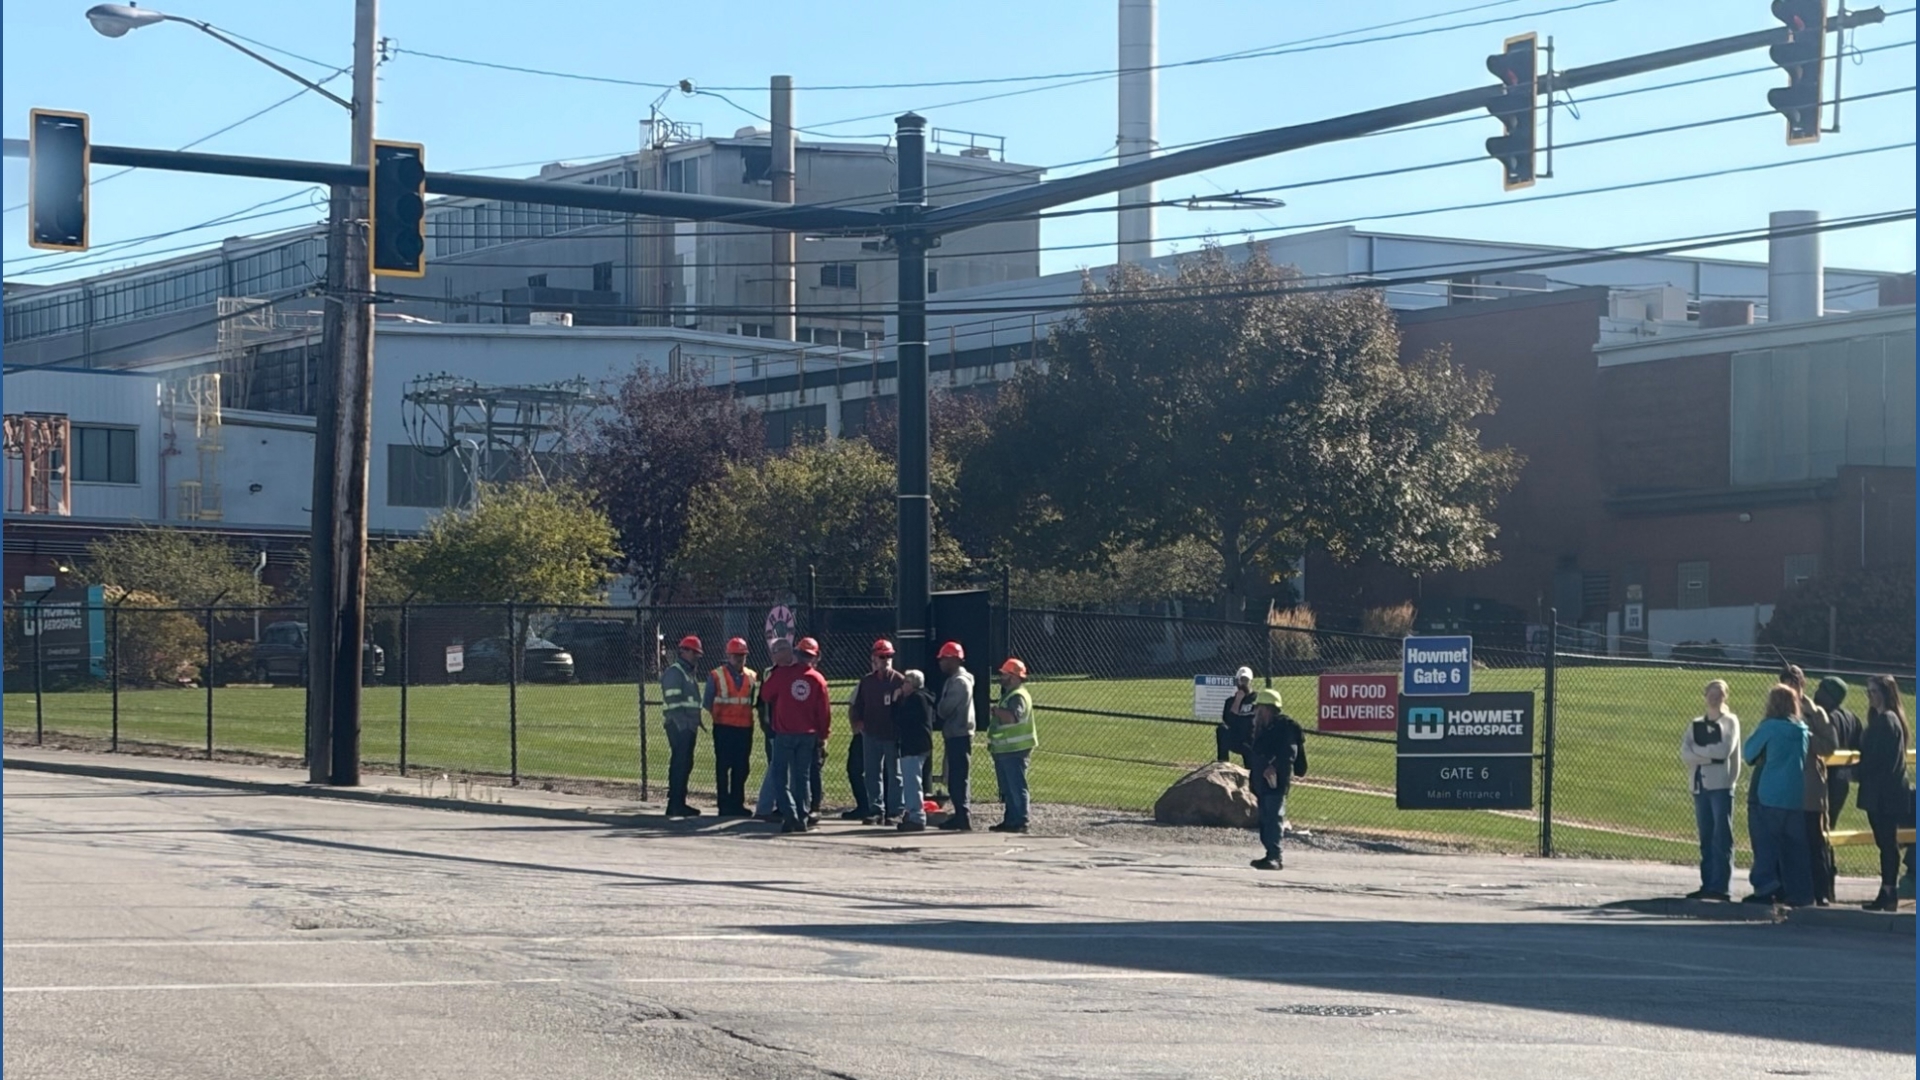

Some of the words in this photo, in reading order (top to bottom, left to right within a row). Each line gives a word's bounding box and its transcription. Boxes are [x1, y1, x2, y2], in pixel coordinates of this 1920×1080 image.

[1407, 648, 1468, 664] Howmet
[1205, 676, 1235, 686] NOTICE
[1413, 668, 1447, 684] Gate
[1451, 668, 1461, 684] 6
[1330, 684, 1348, 699] NO
[1352, 684, 1386, 699] FOOD
[1321, 705, 1395, 720] DELIVERIES
[1448, 710, 1524, 723] HOWMET
[1448, 724, 1523, 736] AEROSPACE
[1440, 767, 1474, 780] GATE
[1481, 767, 1489, 780] 6
[1427, 790, 1452, 799] Main
[1456, 789, 1501, 799] Entrance
